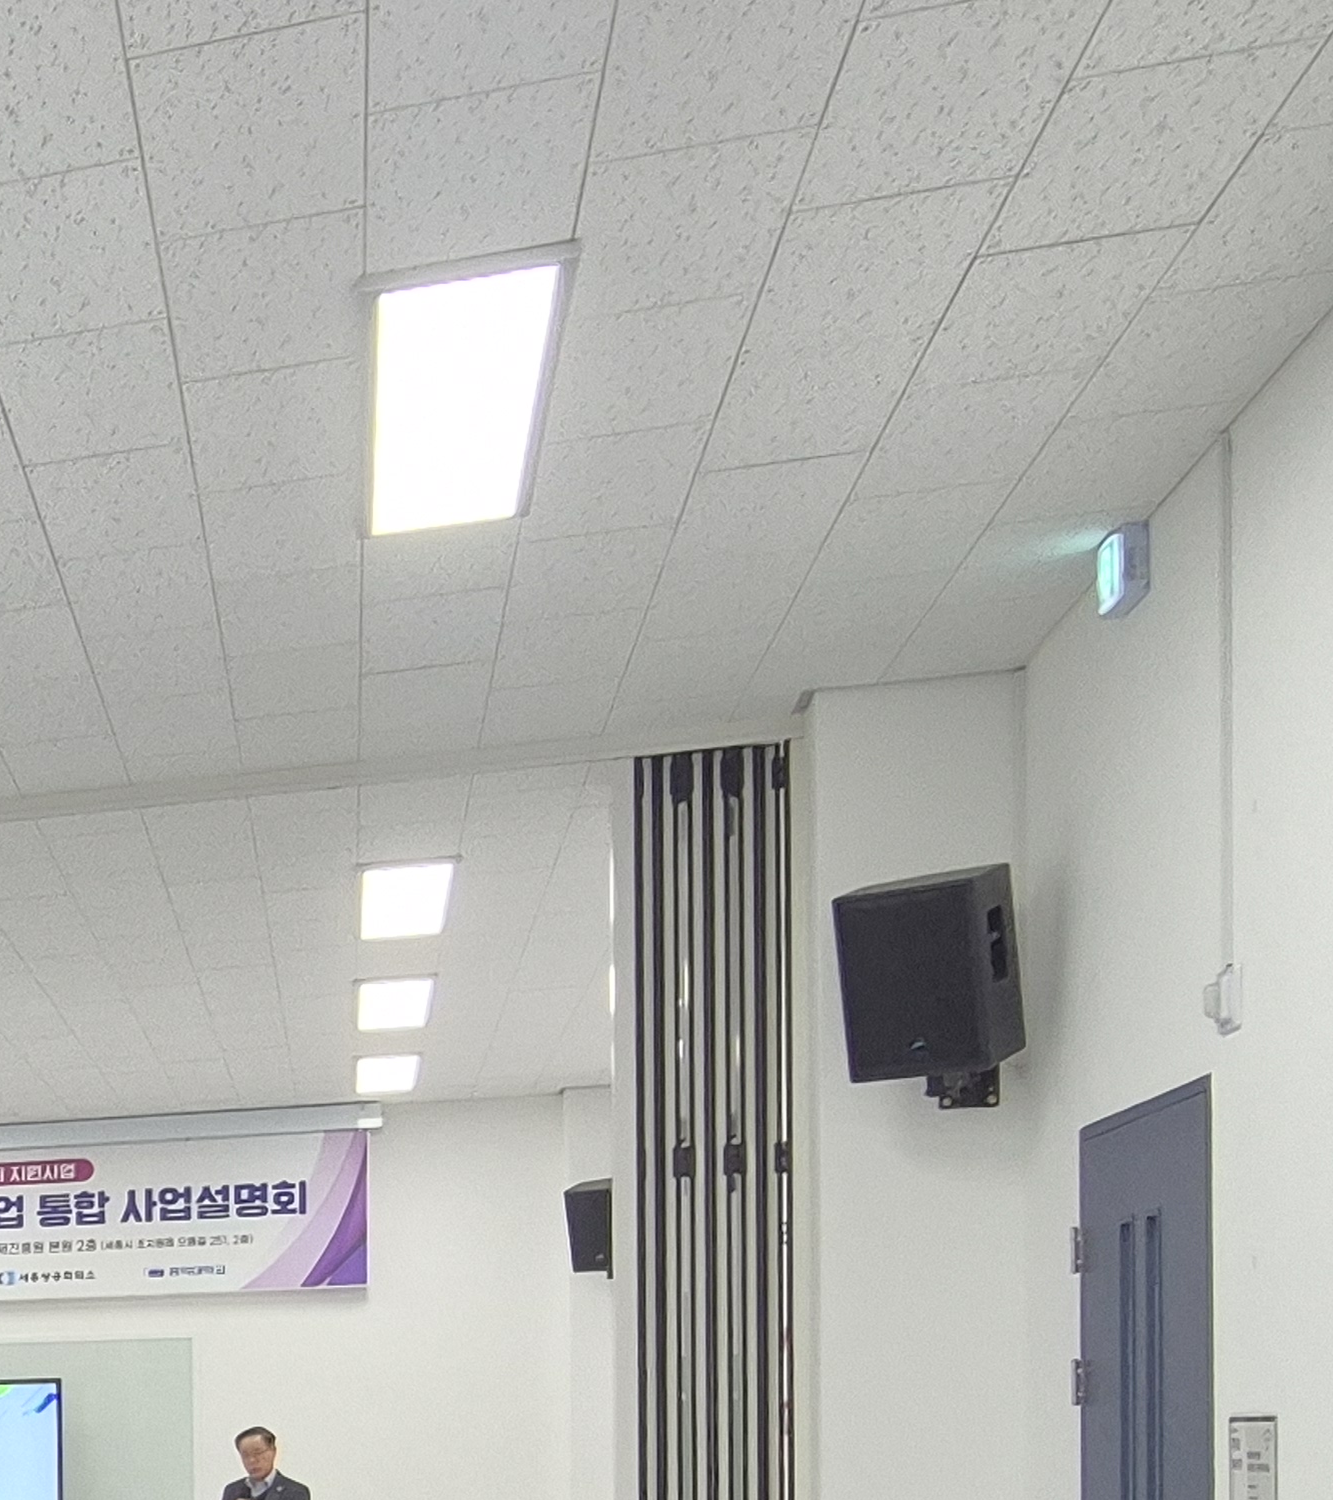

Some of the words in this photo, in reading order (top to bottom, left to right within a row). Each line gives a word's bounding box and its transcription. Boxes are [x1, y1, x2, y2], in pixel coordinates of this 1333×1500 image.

[10, 1163, 76, 1182] 지원사업
[36, 1190, 110, 1227] 통합
[120, 1179, 307, 1223] 사업설명회
[77, 1238, 96, 1252] 2층
